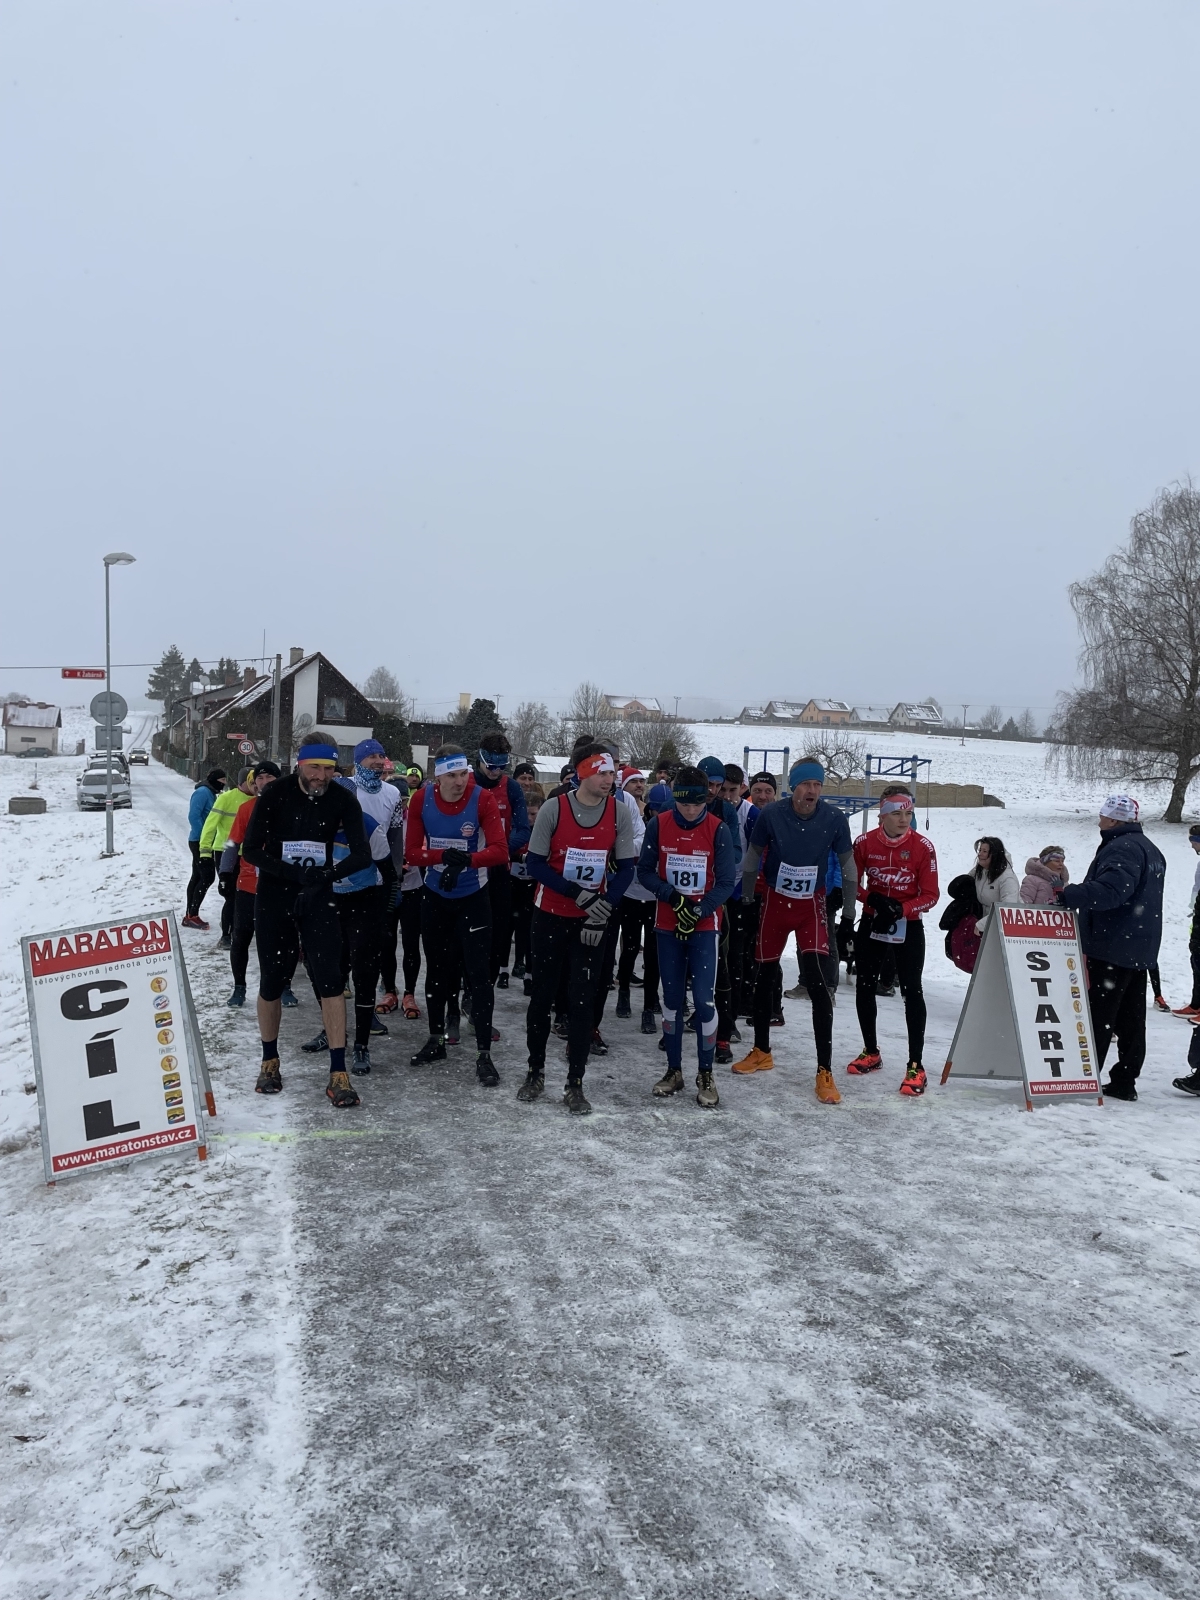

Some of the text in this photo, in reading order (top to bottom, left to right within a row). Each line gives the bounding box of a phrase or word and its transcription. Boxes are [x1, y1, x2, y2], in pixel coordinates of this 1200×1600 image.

[576, 865, 595, 881] 12
[672, 870, 699, 887] 181
[782, 878, 811, 892] 231
[1000, 908, 1074, 928] MARATON
[29, 918, 169, 962] MARATON
[1055, 929, 1074, 937] stav
[131, 941, 167, 955] stav
[34, 954, 173, 986] tělovýchovná jednota Úpice
[1025, 951, 1065, 1077] START
[60, 979, 141, 1141] CÍL
[1032, 1081, 1096, 1092] www.maratonstav.cz
[57, 1129, 192, 1167] www.maratonstav.cz
